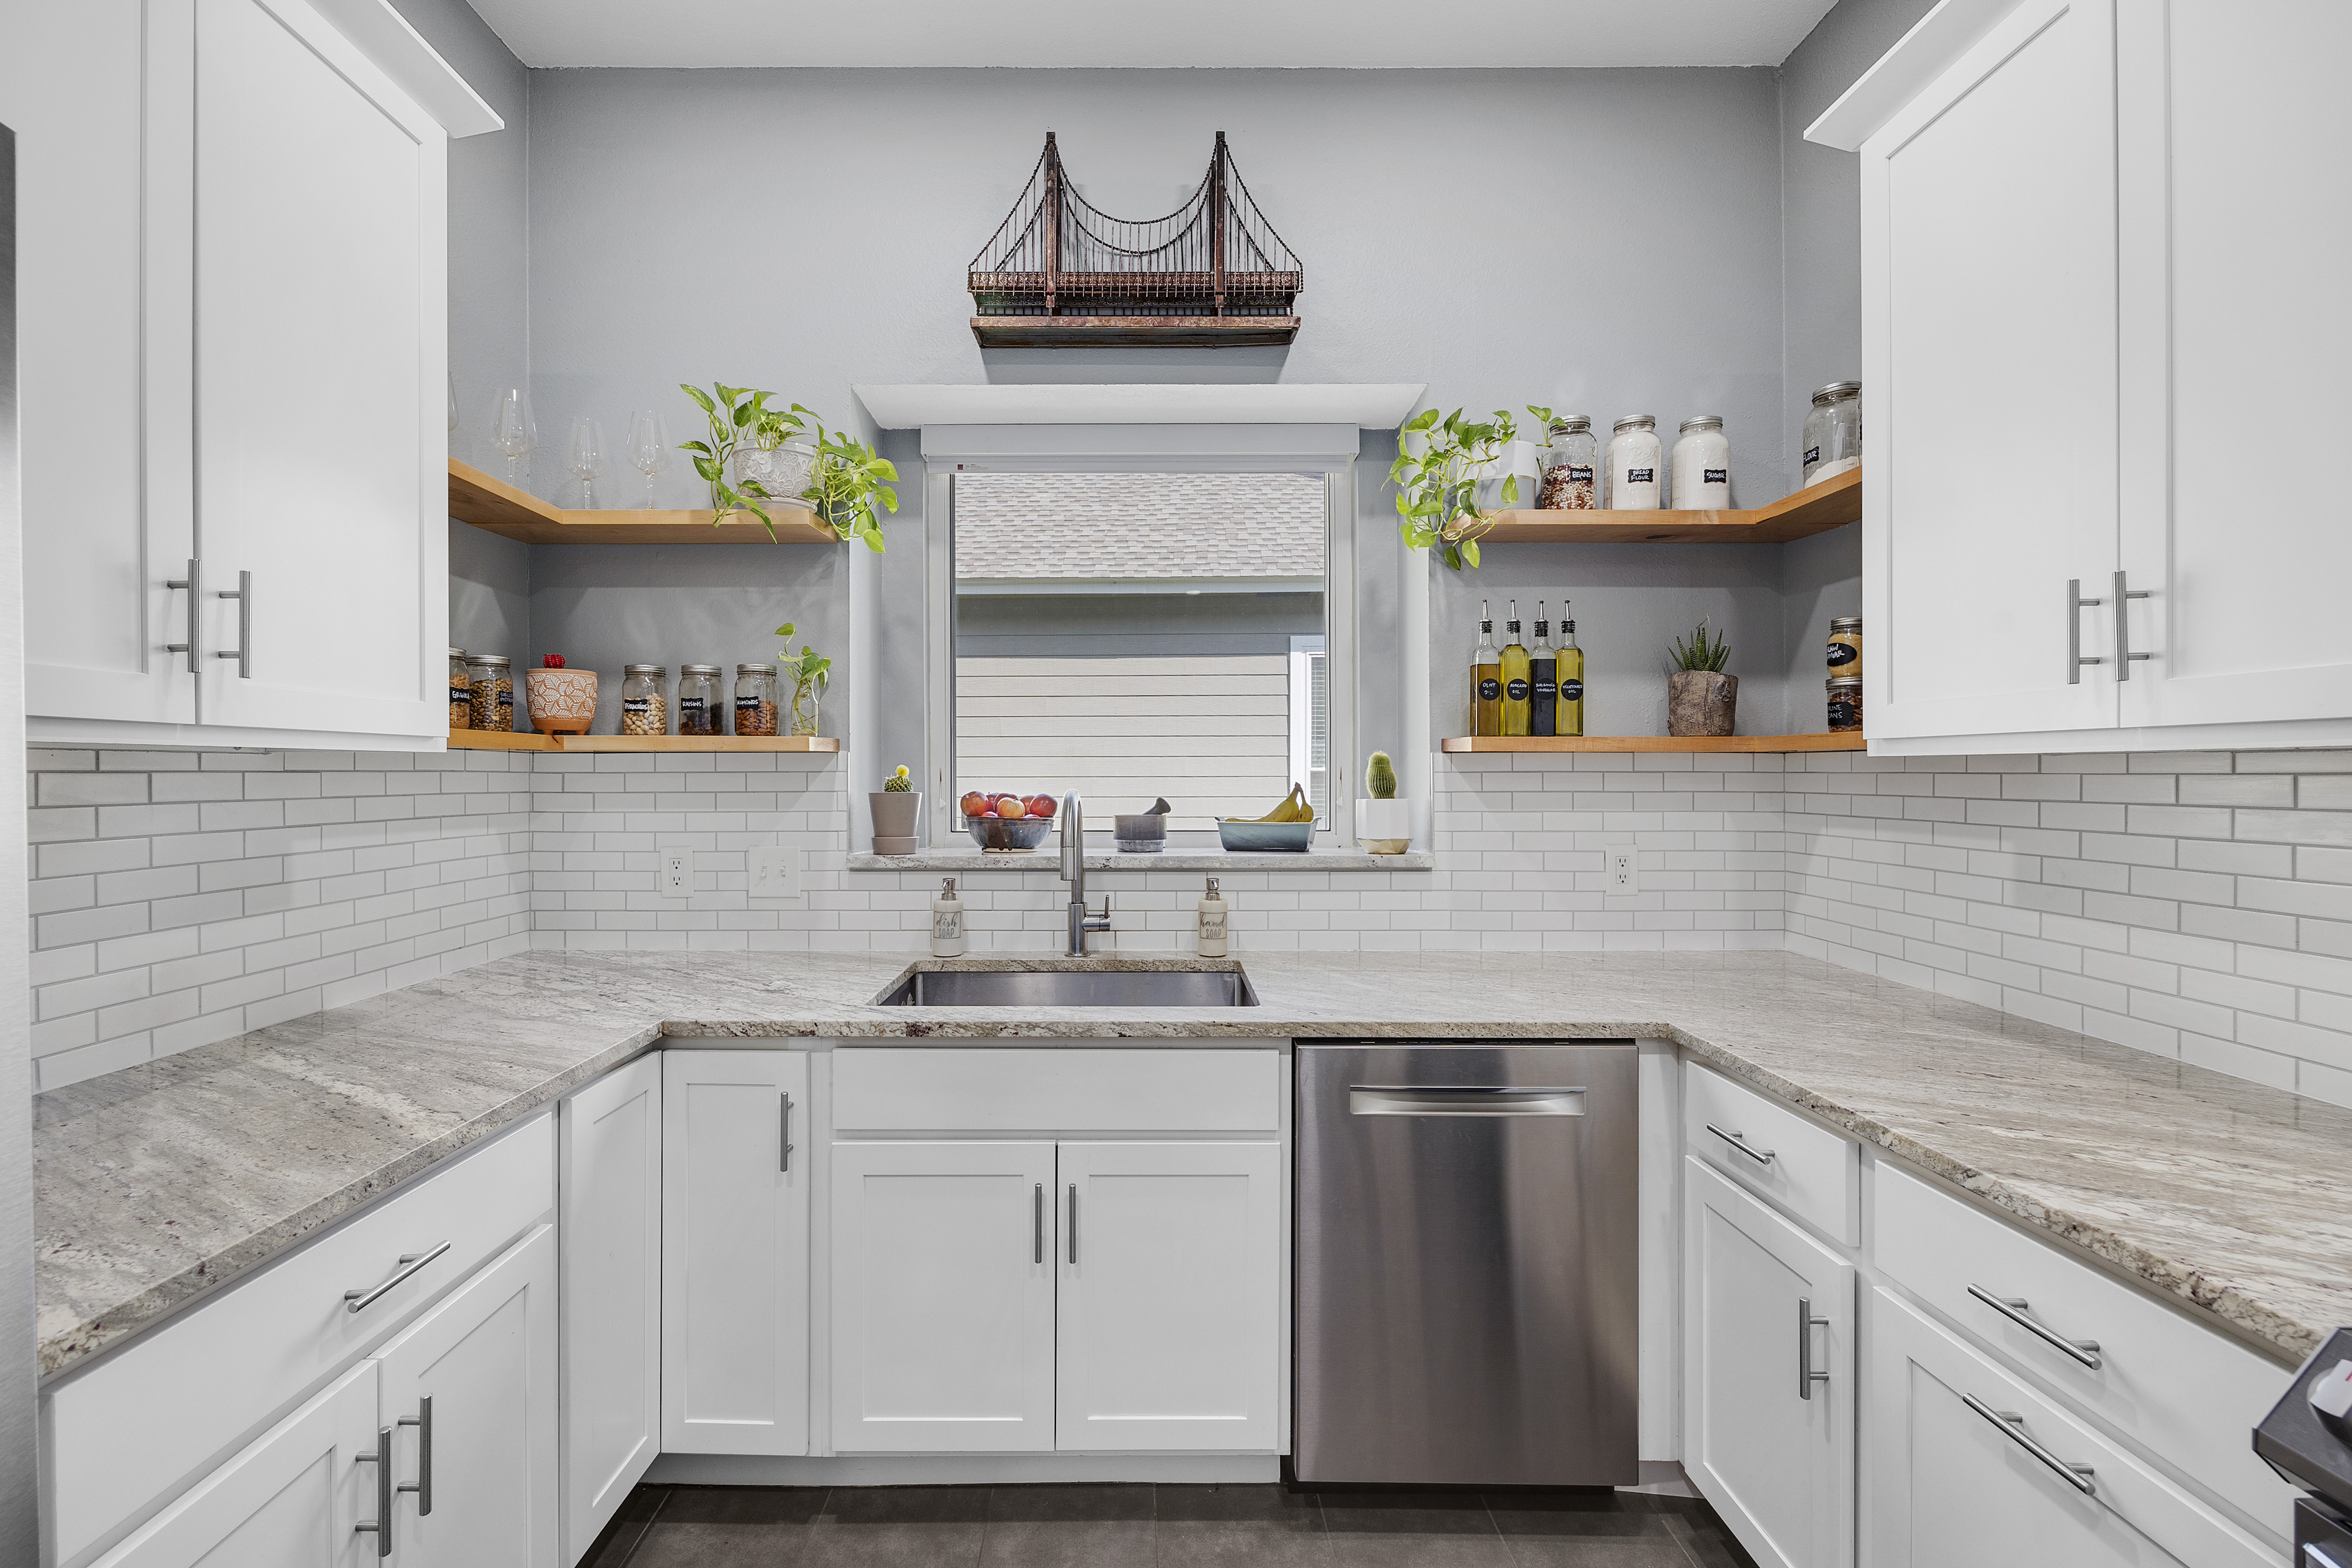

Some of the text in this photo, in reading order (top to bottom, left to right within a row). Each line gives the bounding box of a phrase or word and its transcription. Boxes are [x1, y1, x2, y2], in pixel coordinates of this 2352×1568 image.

[1572, 471, 1592, 479] BEANS
[936, 912, 958, 928] dish
[1200, 913, 1226, 928] hand
[938, 928, 954, 938] SOAP
[1206, 928, 1222, 938] SOAP
